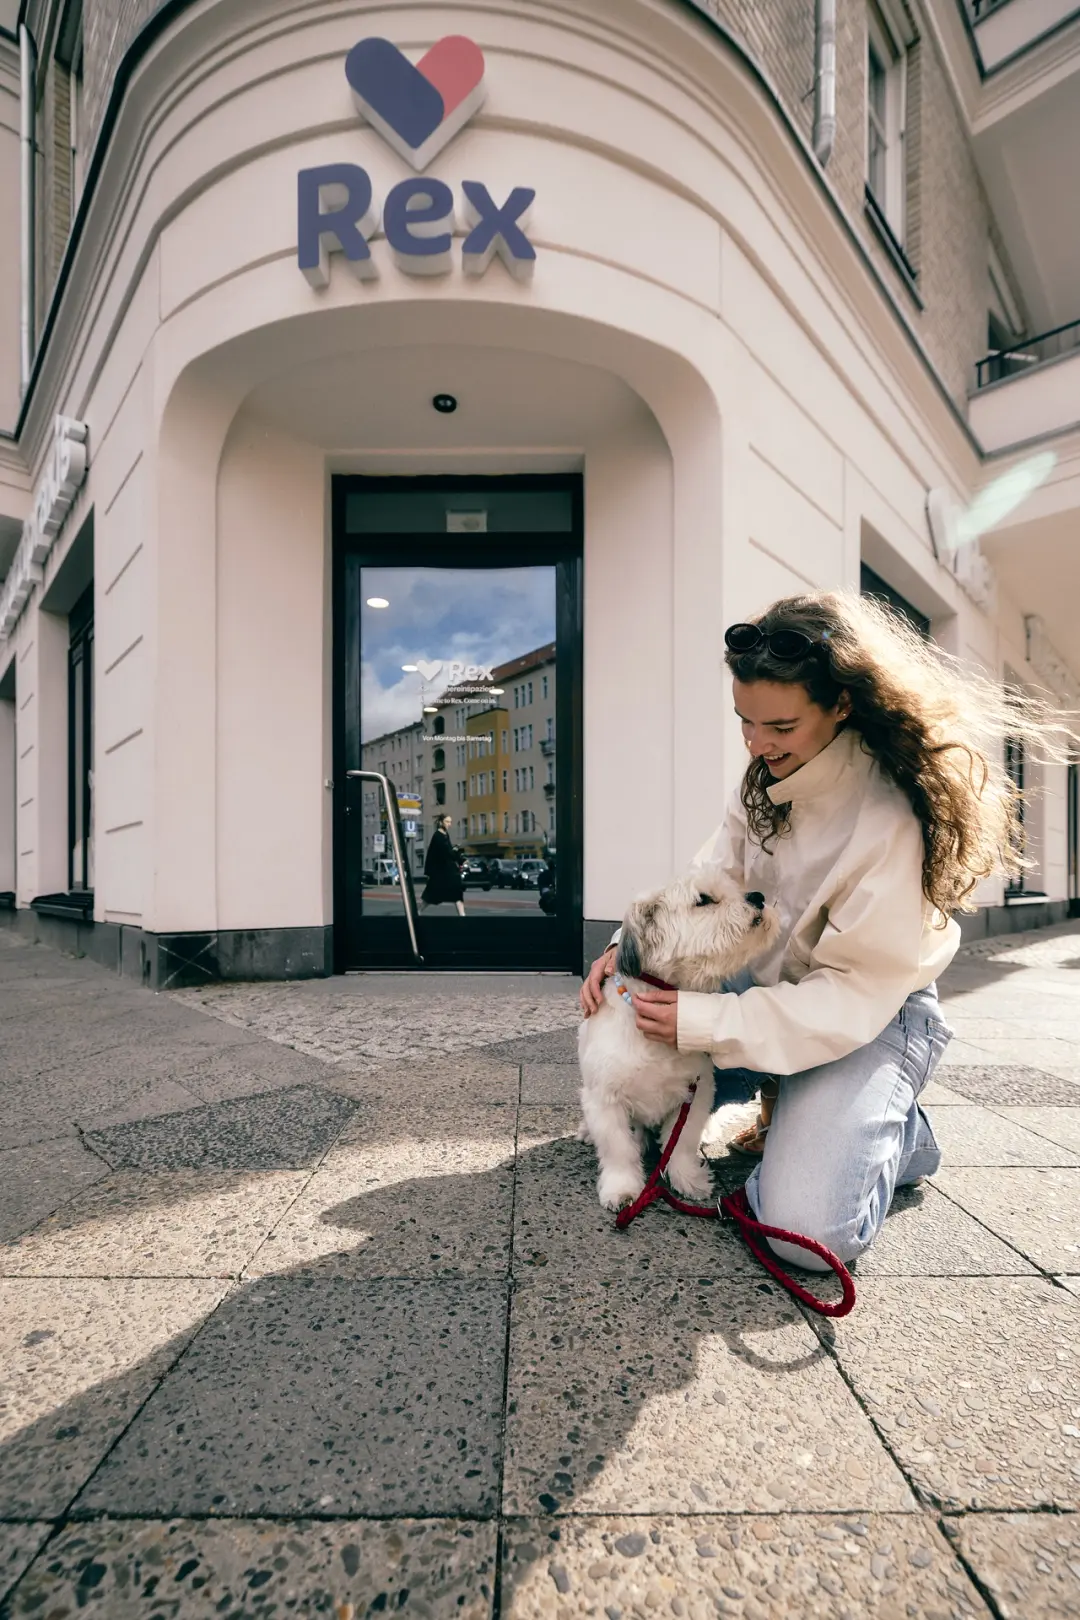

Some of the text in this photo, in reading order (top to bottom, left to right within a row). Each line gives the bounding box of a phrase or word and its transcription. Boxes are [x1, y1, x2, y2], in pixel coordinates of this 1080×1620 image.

[298, 162, 536, 270] Rex
[449, 661, 494, 681] Rex
[434, 735, 456, 743] Montag
[466, 735, 492, 743] Samstag
[407, 821, 415, 831] U
